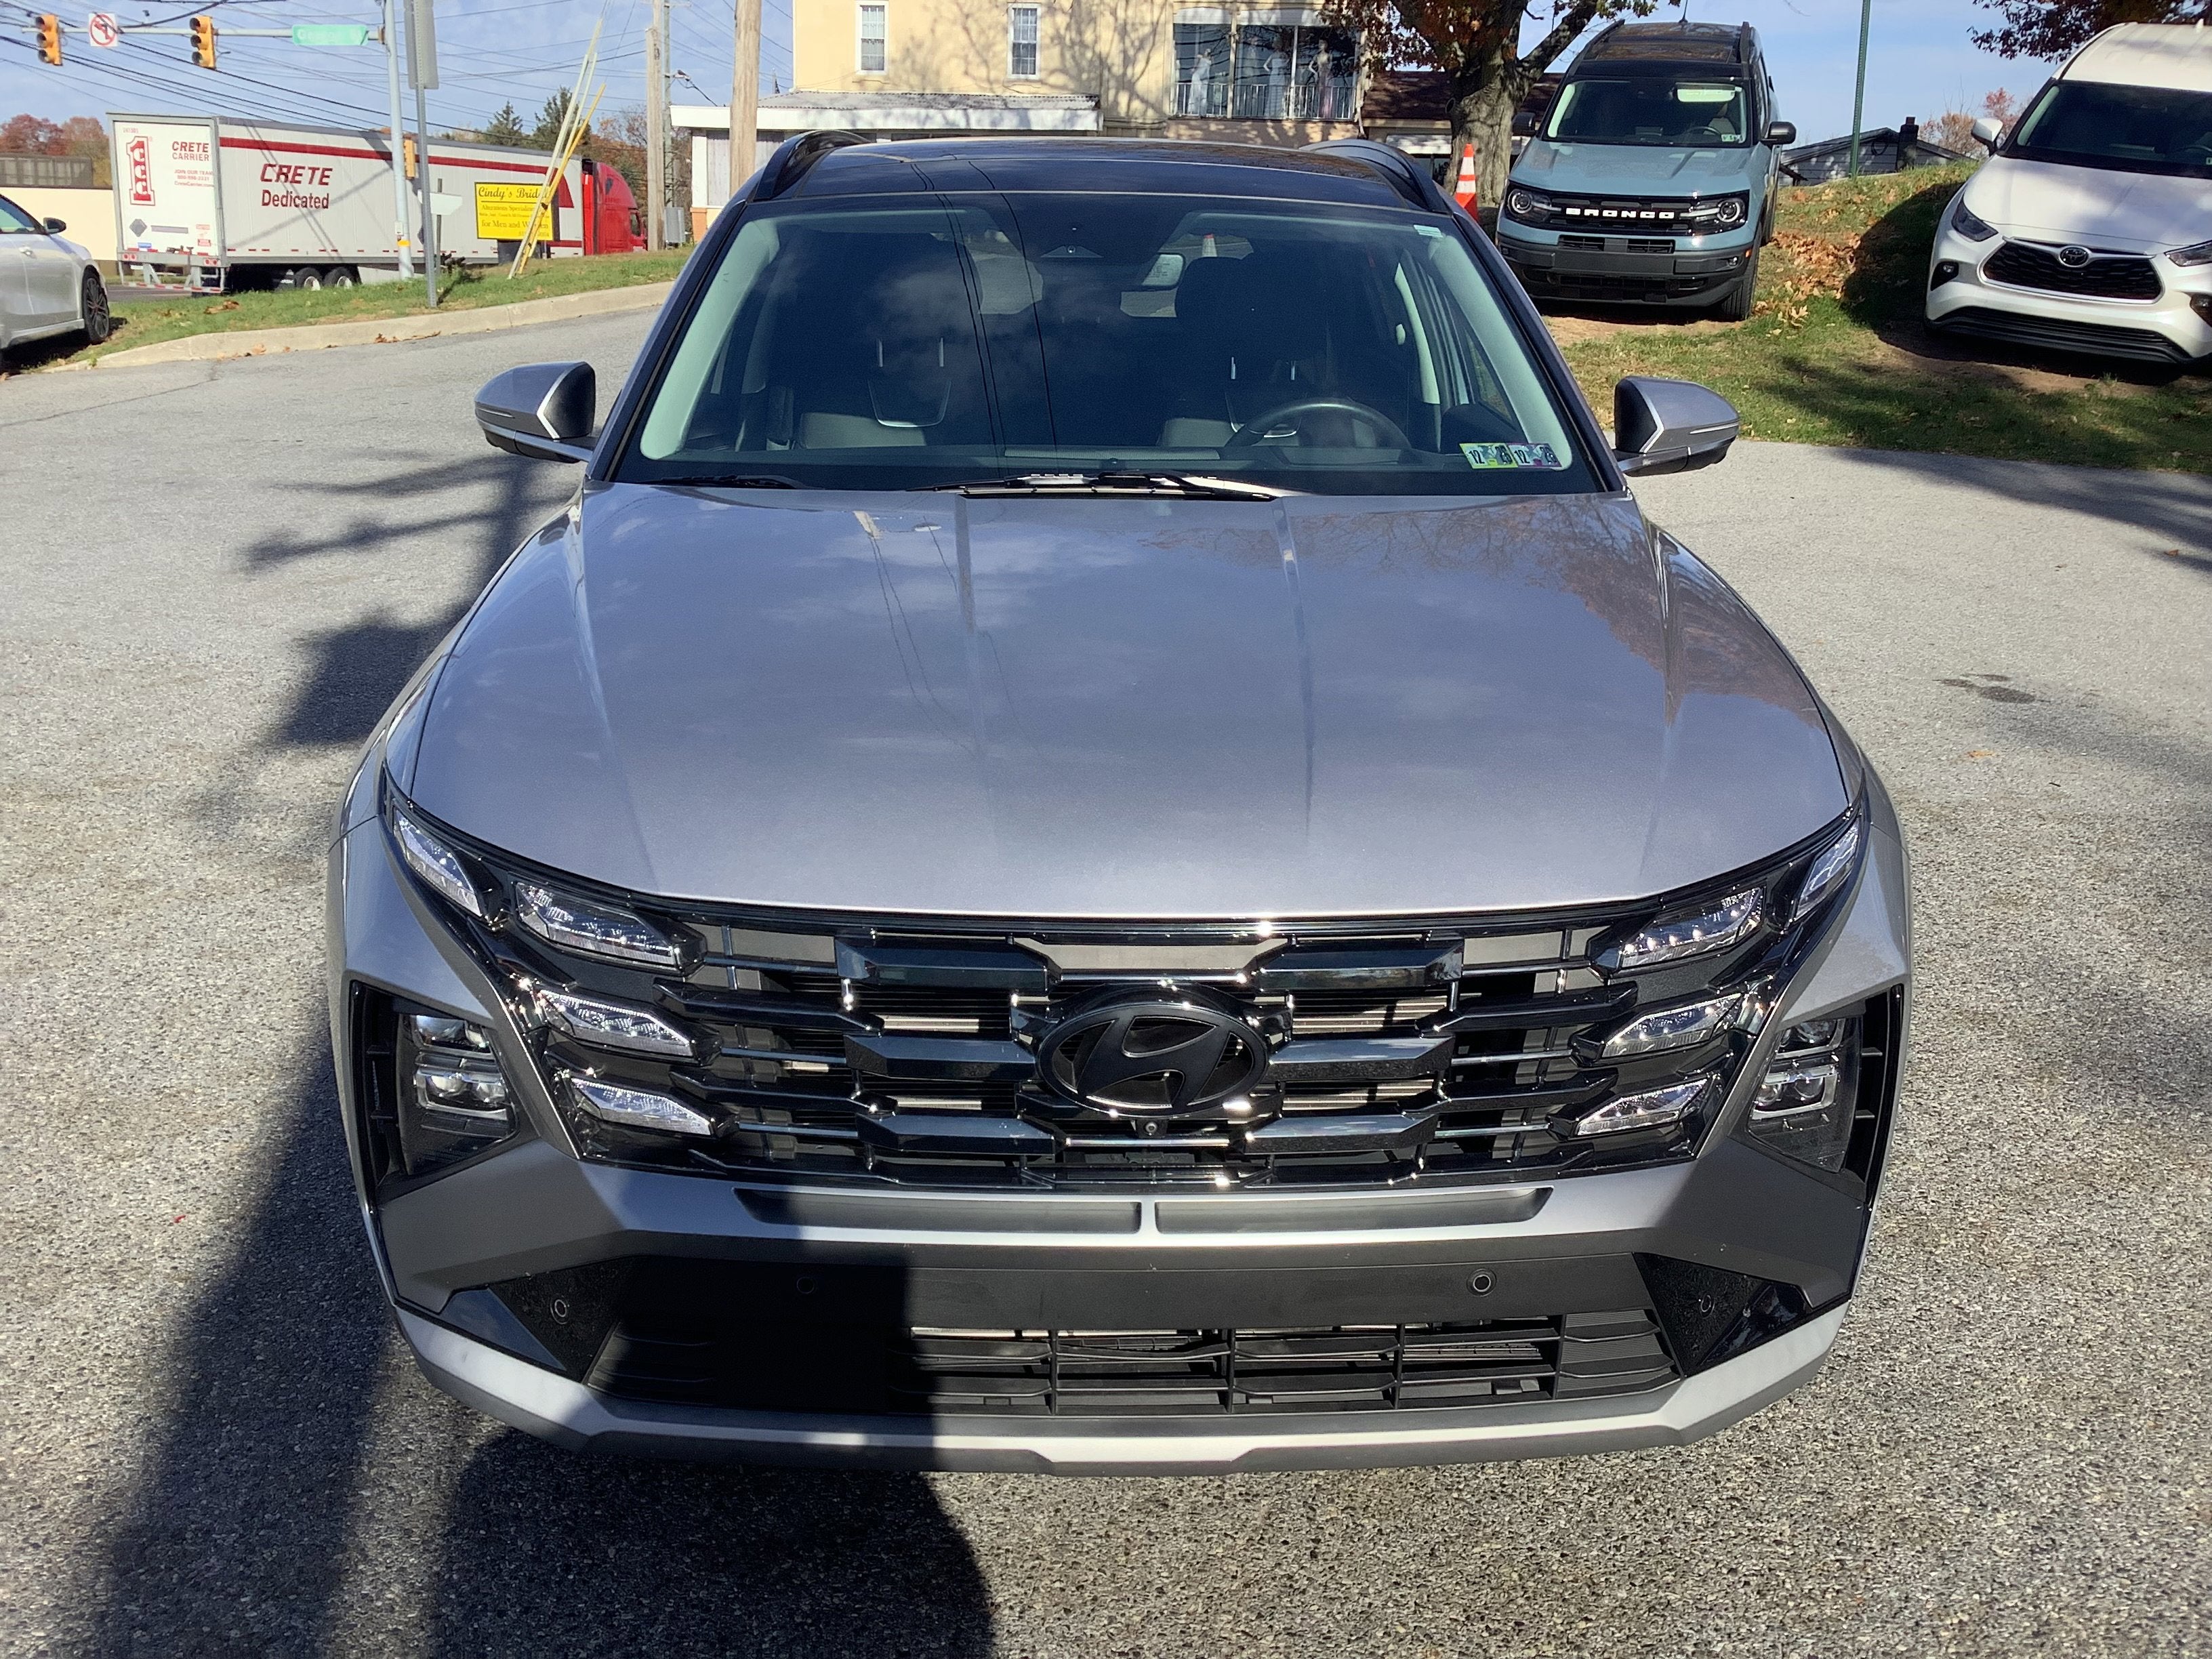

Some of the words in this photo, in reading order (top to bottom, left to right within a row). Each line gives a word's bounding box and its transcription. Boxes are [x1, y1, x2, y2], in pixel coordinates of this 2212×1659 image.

[172, 141, 209, 152] CRETE
[172, 152, 209, 161] CARRIER
[260, 163, 333, 186] CRETE
[261, 189, 329, 209] Dedicated
[478, 186, 513, 201] Cindy's
[1565, 207, 1675, 219] BRONCO
[1469, 449, 1485, 464] 12
[1514, 449, 1530, 464] 12
